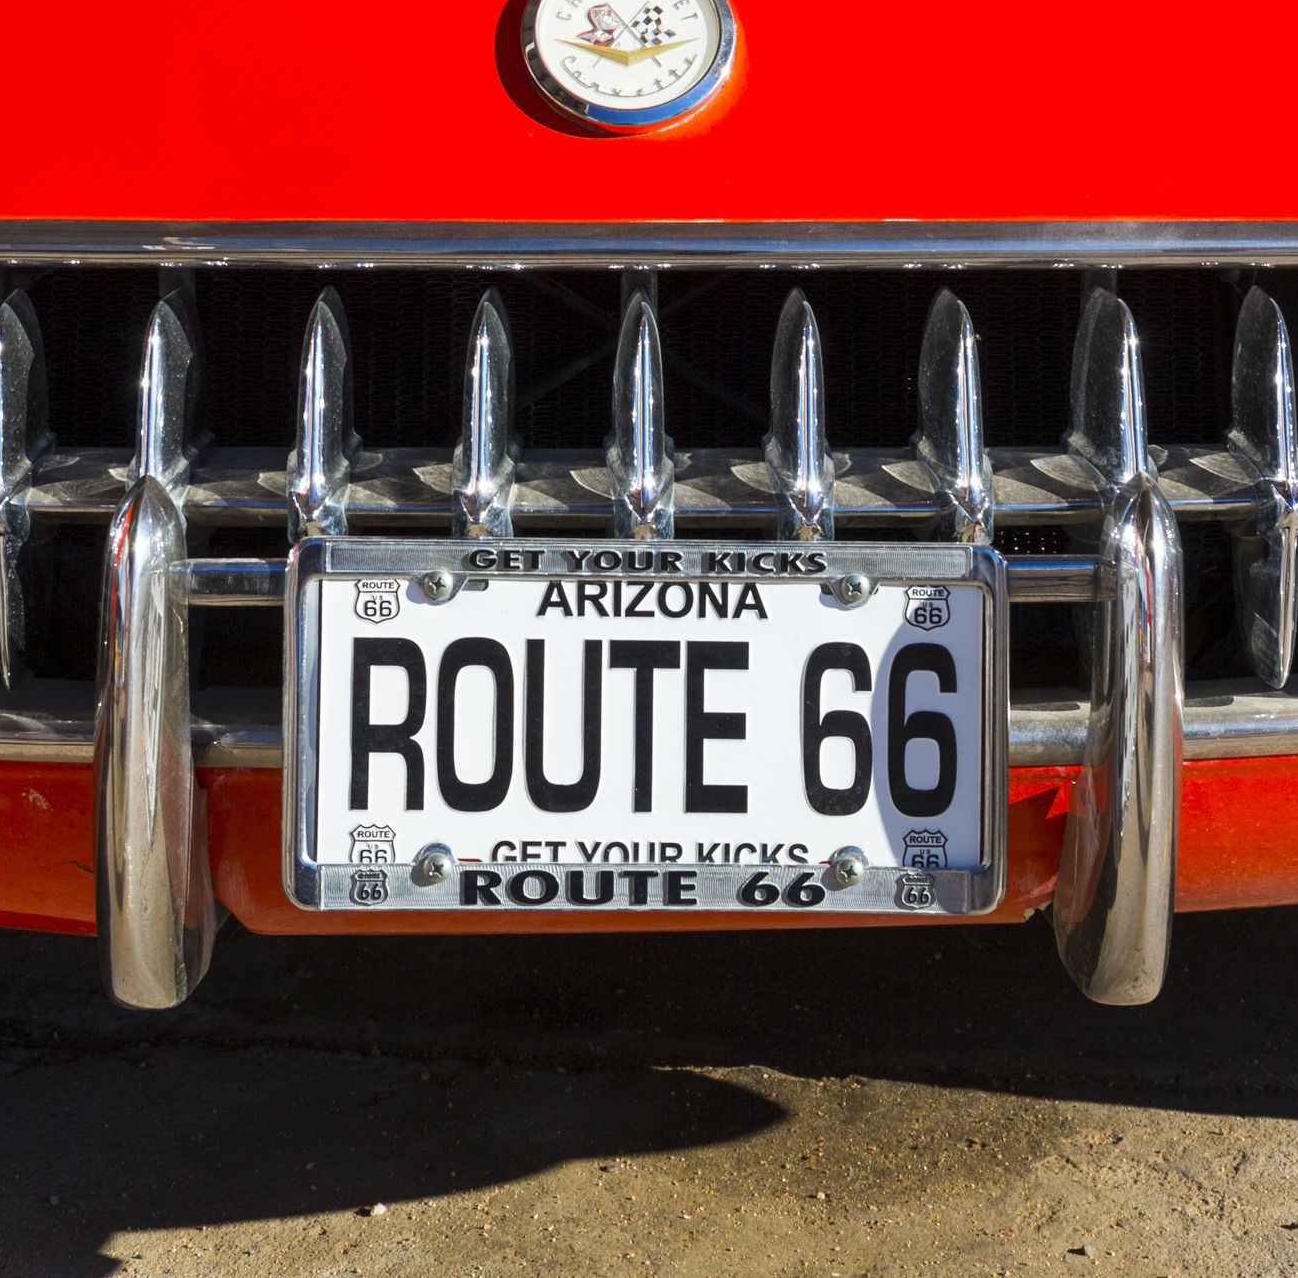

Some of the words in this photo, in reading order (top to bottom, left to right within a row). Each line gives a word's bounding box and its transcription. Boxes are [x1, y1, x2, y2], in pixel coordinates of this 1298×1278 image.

[560, 53, 698, 98] Corvette
[468, 548, 546, 571] GET
[563, 549, 684, 573] YOUR
[707, 550, 828, 574] KICKS
[362, 581, 395, 590] ROUTE
[911, 588, 945, 598] ROUTE
[537, 579, 769, 620] ARIZONA
[364, 600, 392, 618] 66
[913, 607, 943, 625] 66
[347, 636, 750, 814] ROUTE
[799, 640, 958, 818] 66
[357, 830, 391, 839] ROUTE
[909, 835, 943, 844] ROUTE
[491, 840, 567, 864] GET
[574, 841, 684, 865] YOUR
[697, 842, 810, 865] KICKS
[357, 883, 382, 901] 66
[459, 869, 699, 906] ROUTE
[739, 870, 827, 908] 66
[907, 887, 930, 904] 66
